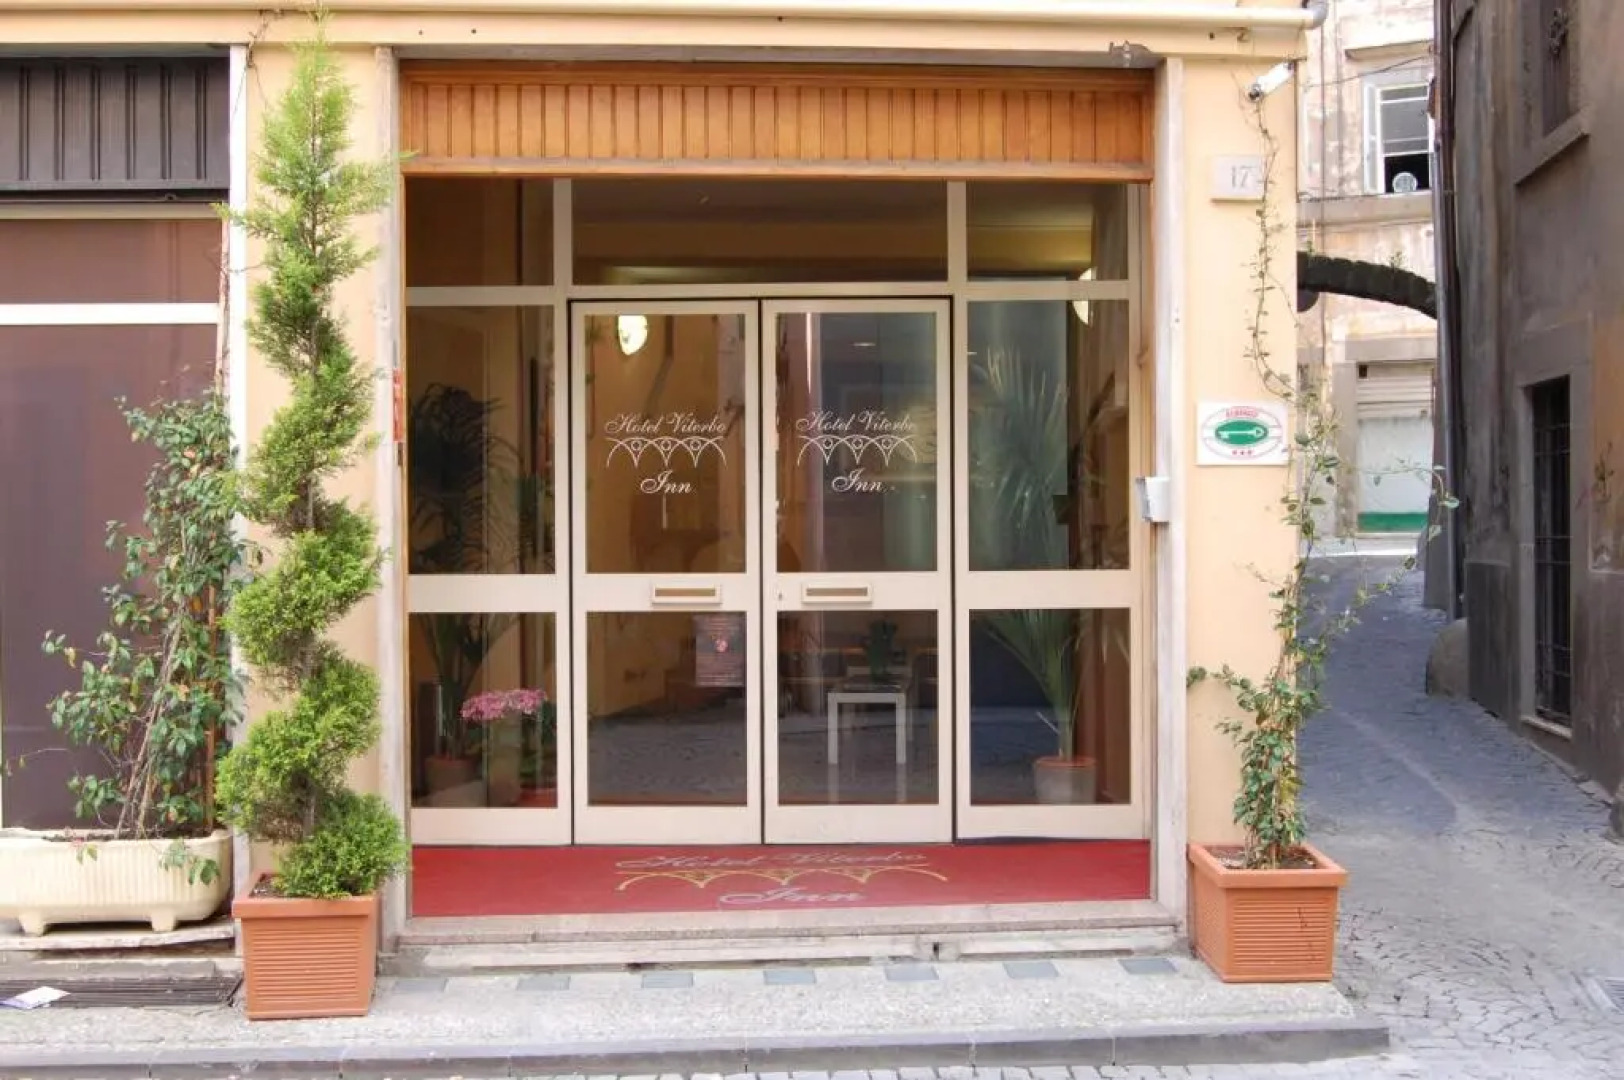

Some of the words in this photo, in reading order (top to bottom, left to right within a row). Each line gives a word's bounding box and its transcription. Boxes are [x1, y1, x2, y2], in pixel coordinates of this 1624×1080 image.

[1231, 165, 1257, 188] 17
[604, 412, 665, 434] Hotel
[665, 411, 727, 434] Viterbo
[795, 409, 856, 432] Hotel
[857, 408, 918, 432] Viterbo
[640, 468, 693, 495] Inn
[831, 466, 884, 493] Inn
